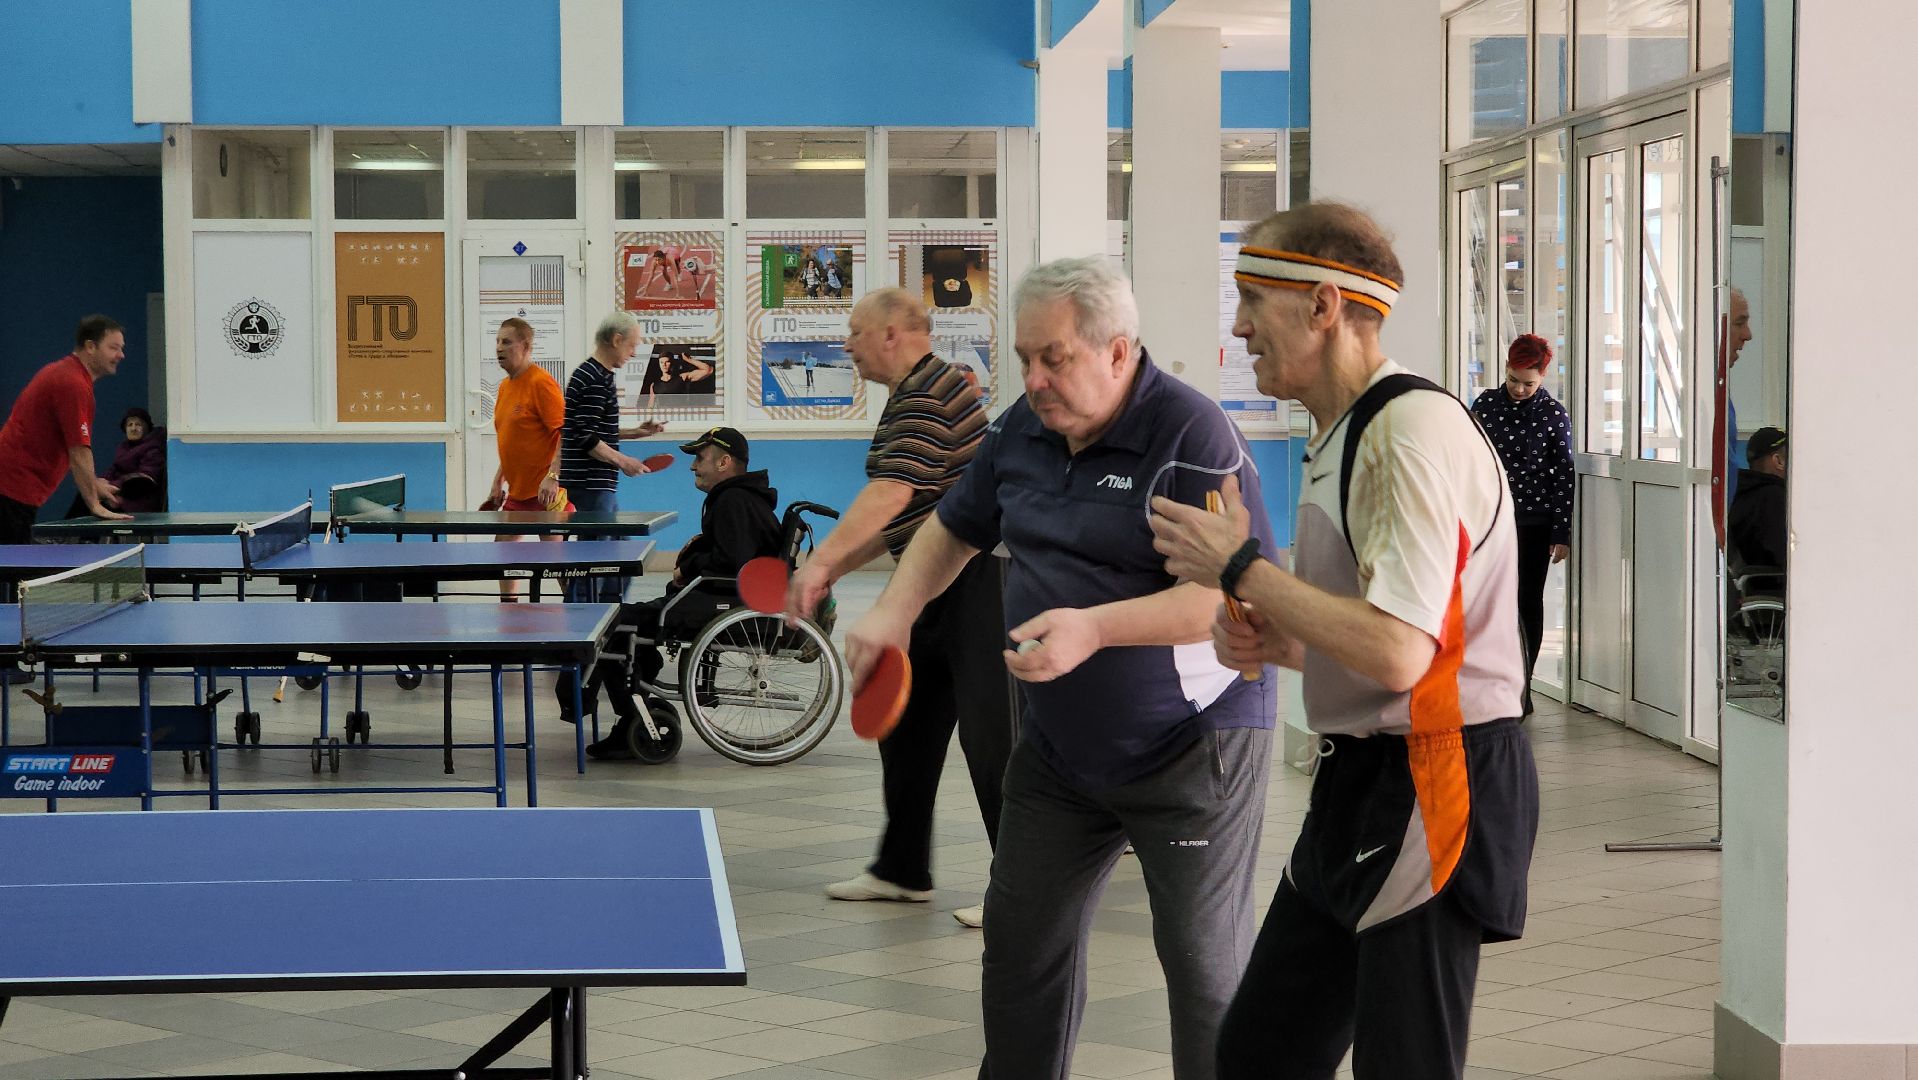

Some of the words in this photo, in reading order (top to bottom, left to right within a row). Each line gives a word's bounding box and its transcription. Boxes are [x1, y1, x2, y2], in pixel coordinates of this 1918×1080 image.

[347, 295, 418, 341] ГТО
[773, 317, 797, 332] ГТО
[638, 319, 660, 333] ТО
[1096, 474, 1133, 490] STIGA
[542, 568, 562, 578] Game
[564, 567, 588, 577] indoor
[7, 757, 71, 771] START
[71, 757, 115, 771] LINE
[14, 775, 55, 792] Game
[57, 775, 105, 792] indoor
